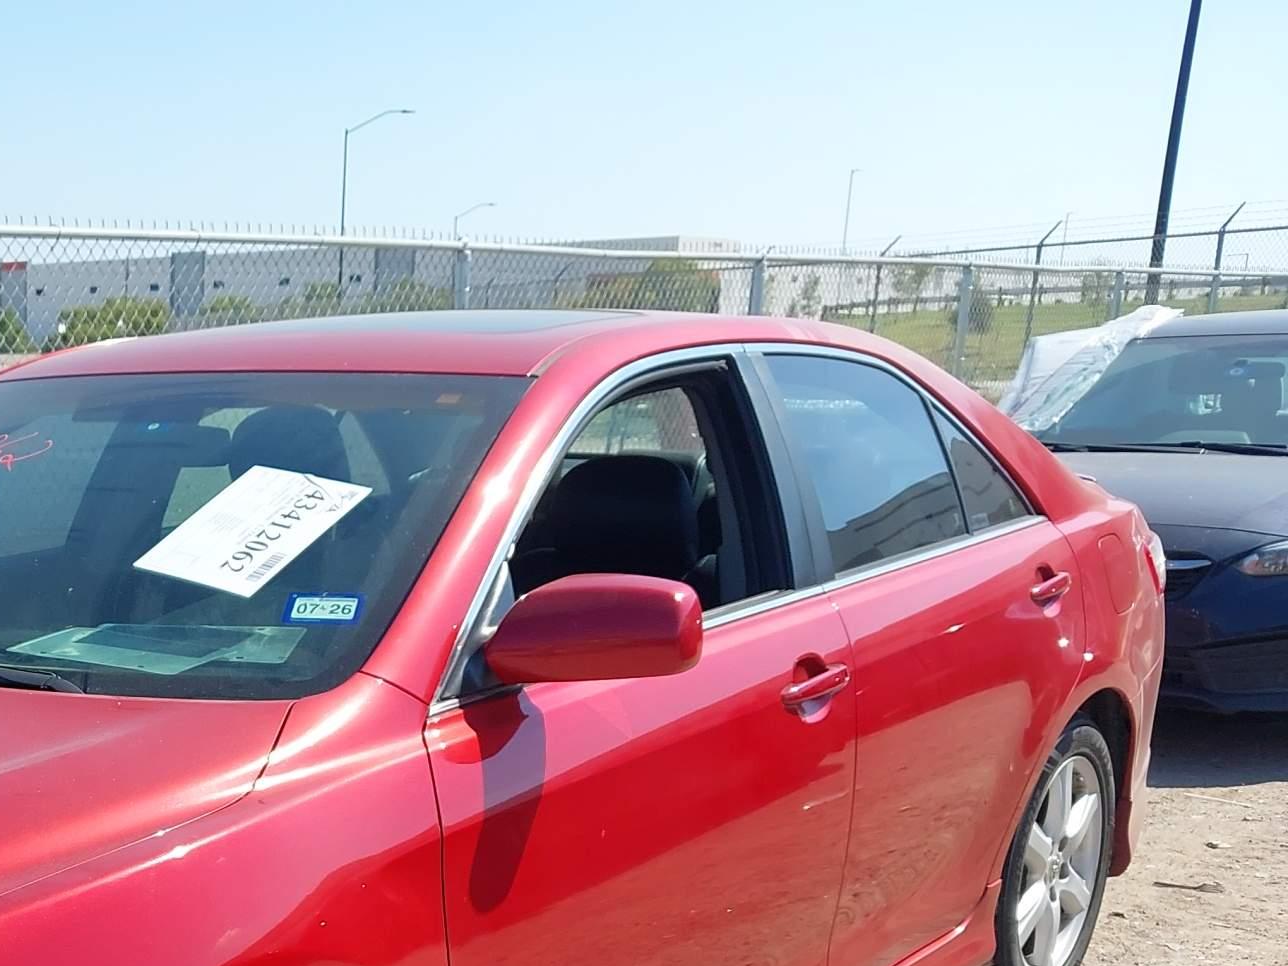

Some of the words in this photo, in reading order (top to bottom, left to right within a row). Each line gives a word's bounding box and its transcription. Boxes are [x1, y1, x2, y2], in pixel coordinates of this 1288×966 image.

[220, 489, 325, 573] 43412062
[296, 602, 320, 614] 07
[328, 603, 353, 615] 26
